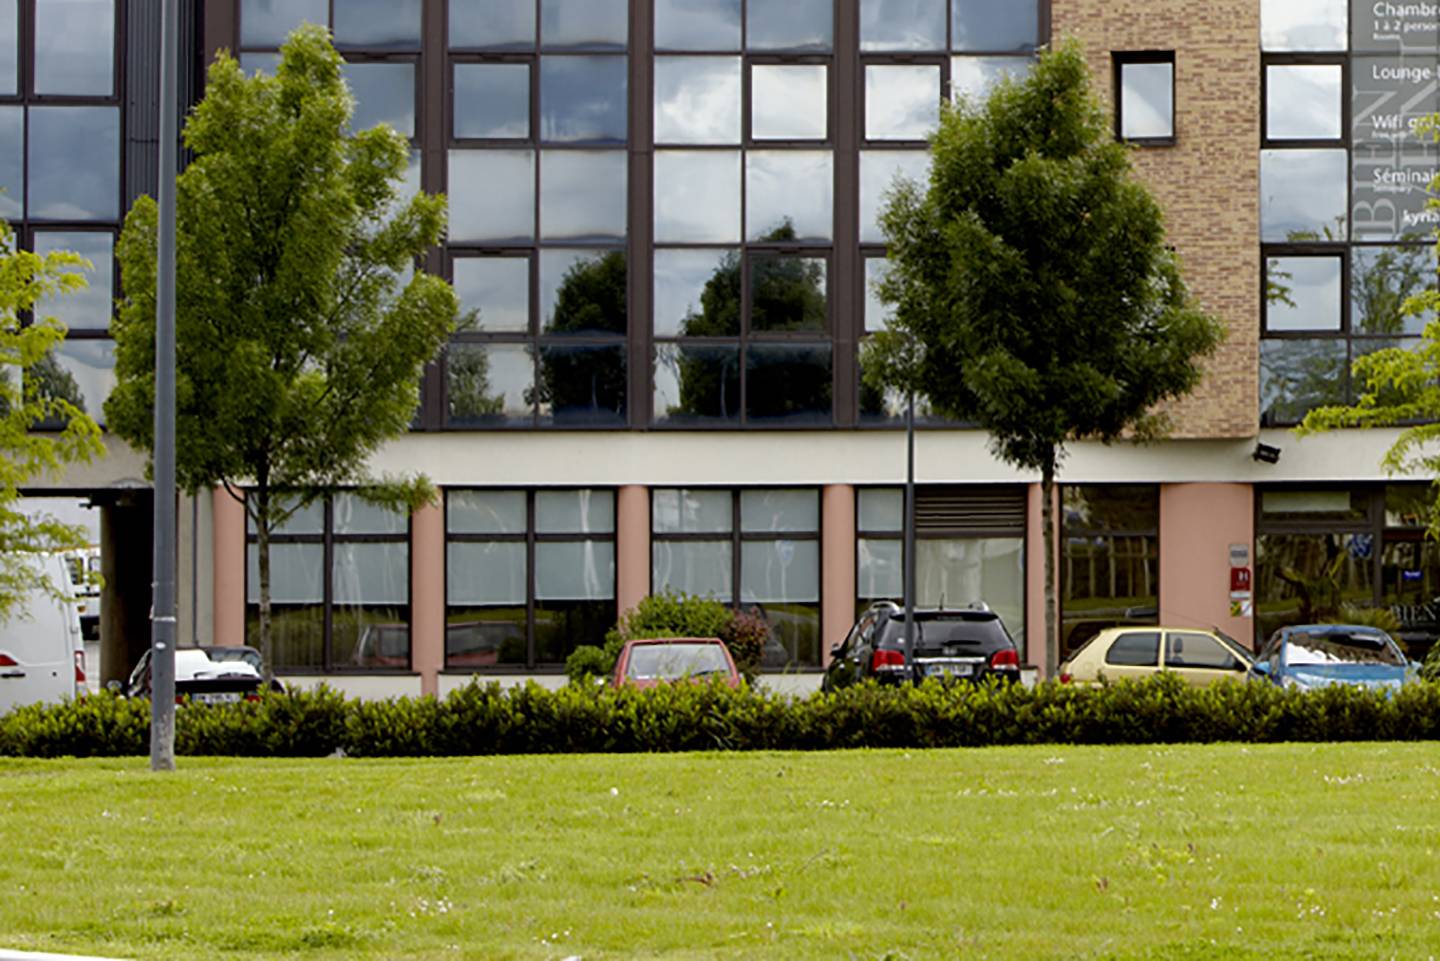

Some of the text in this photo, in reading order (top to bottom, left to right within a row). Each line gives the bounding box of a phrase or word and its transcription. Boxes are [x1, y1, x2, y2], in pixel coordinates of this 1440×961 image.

[1393, 20, 1401, 31] 2
[1372, 65, 1431, 84] Lounge
[1372, 114, 1403, 129] Wifi
